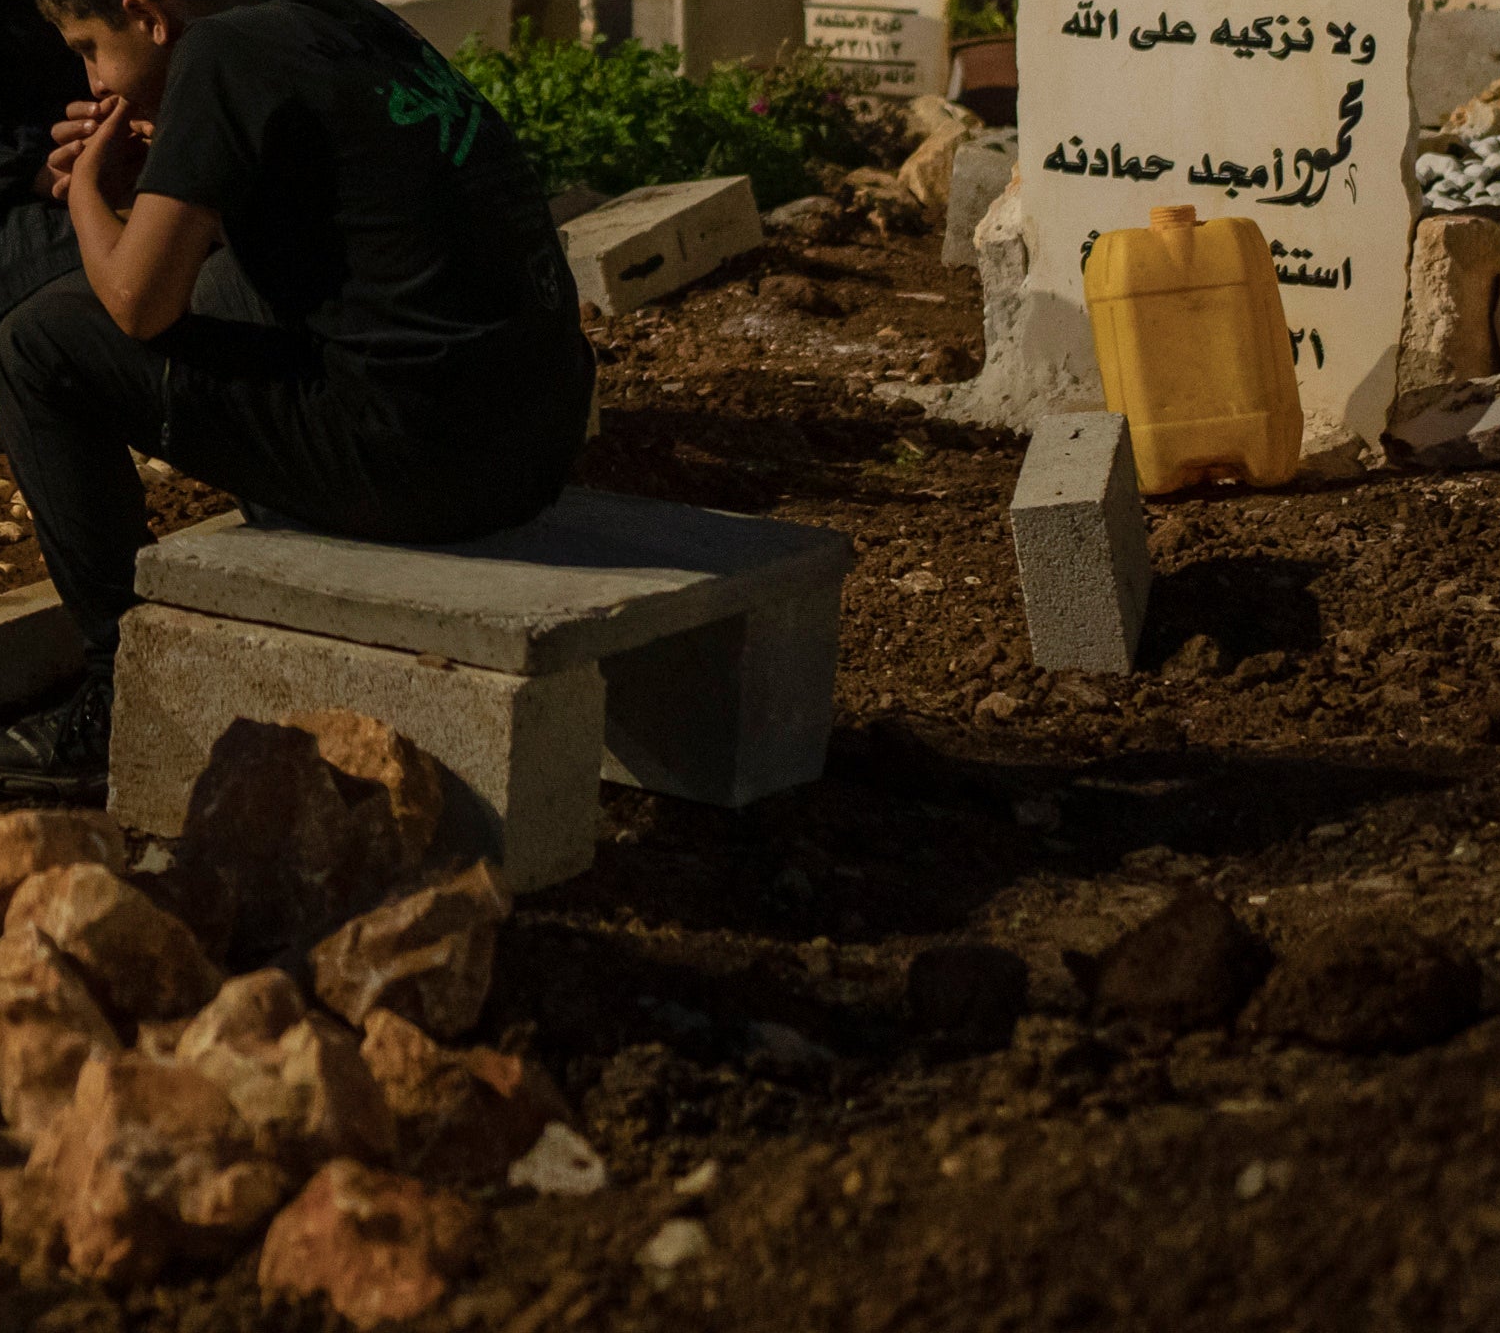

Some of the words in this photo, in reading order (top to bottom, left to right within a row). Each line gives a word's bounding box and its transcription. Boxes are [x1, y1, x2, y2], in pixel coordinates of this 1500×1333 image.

[1061, 0, 1118, 41] الله
[1128, 11, 1198, 52] على
[1209, 14, 1315, 61] نزكيه
[1325, 20, 1377, 65] ولا
